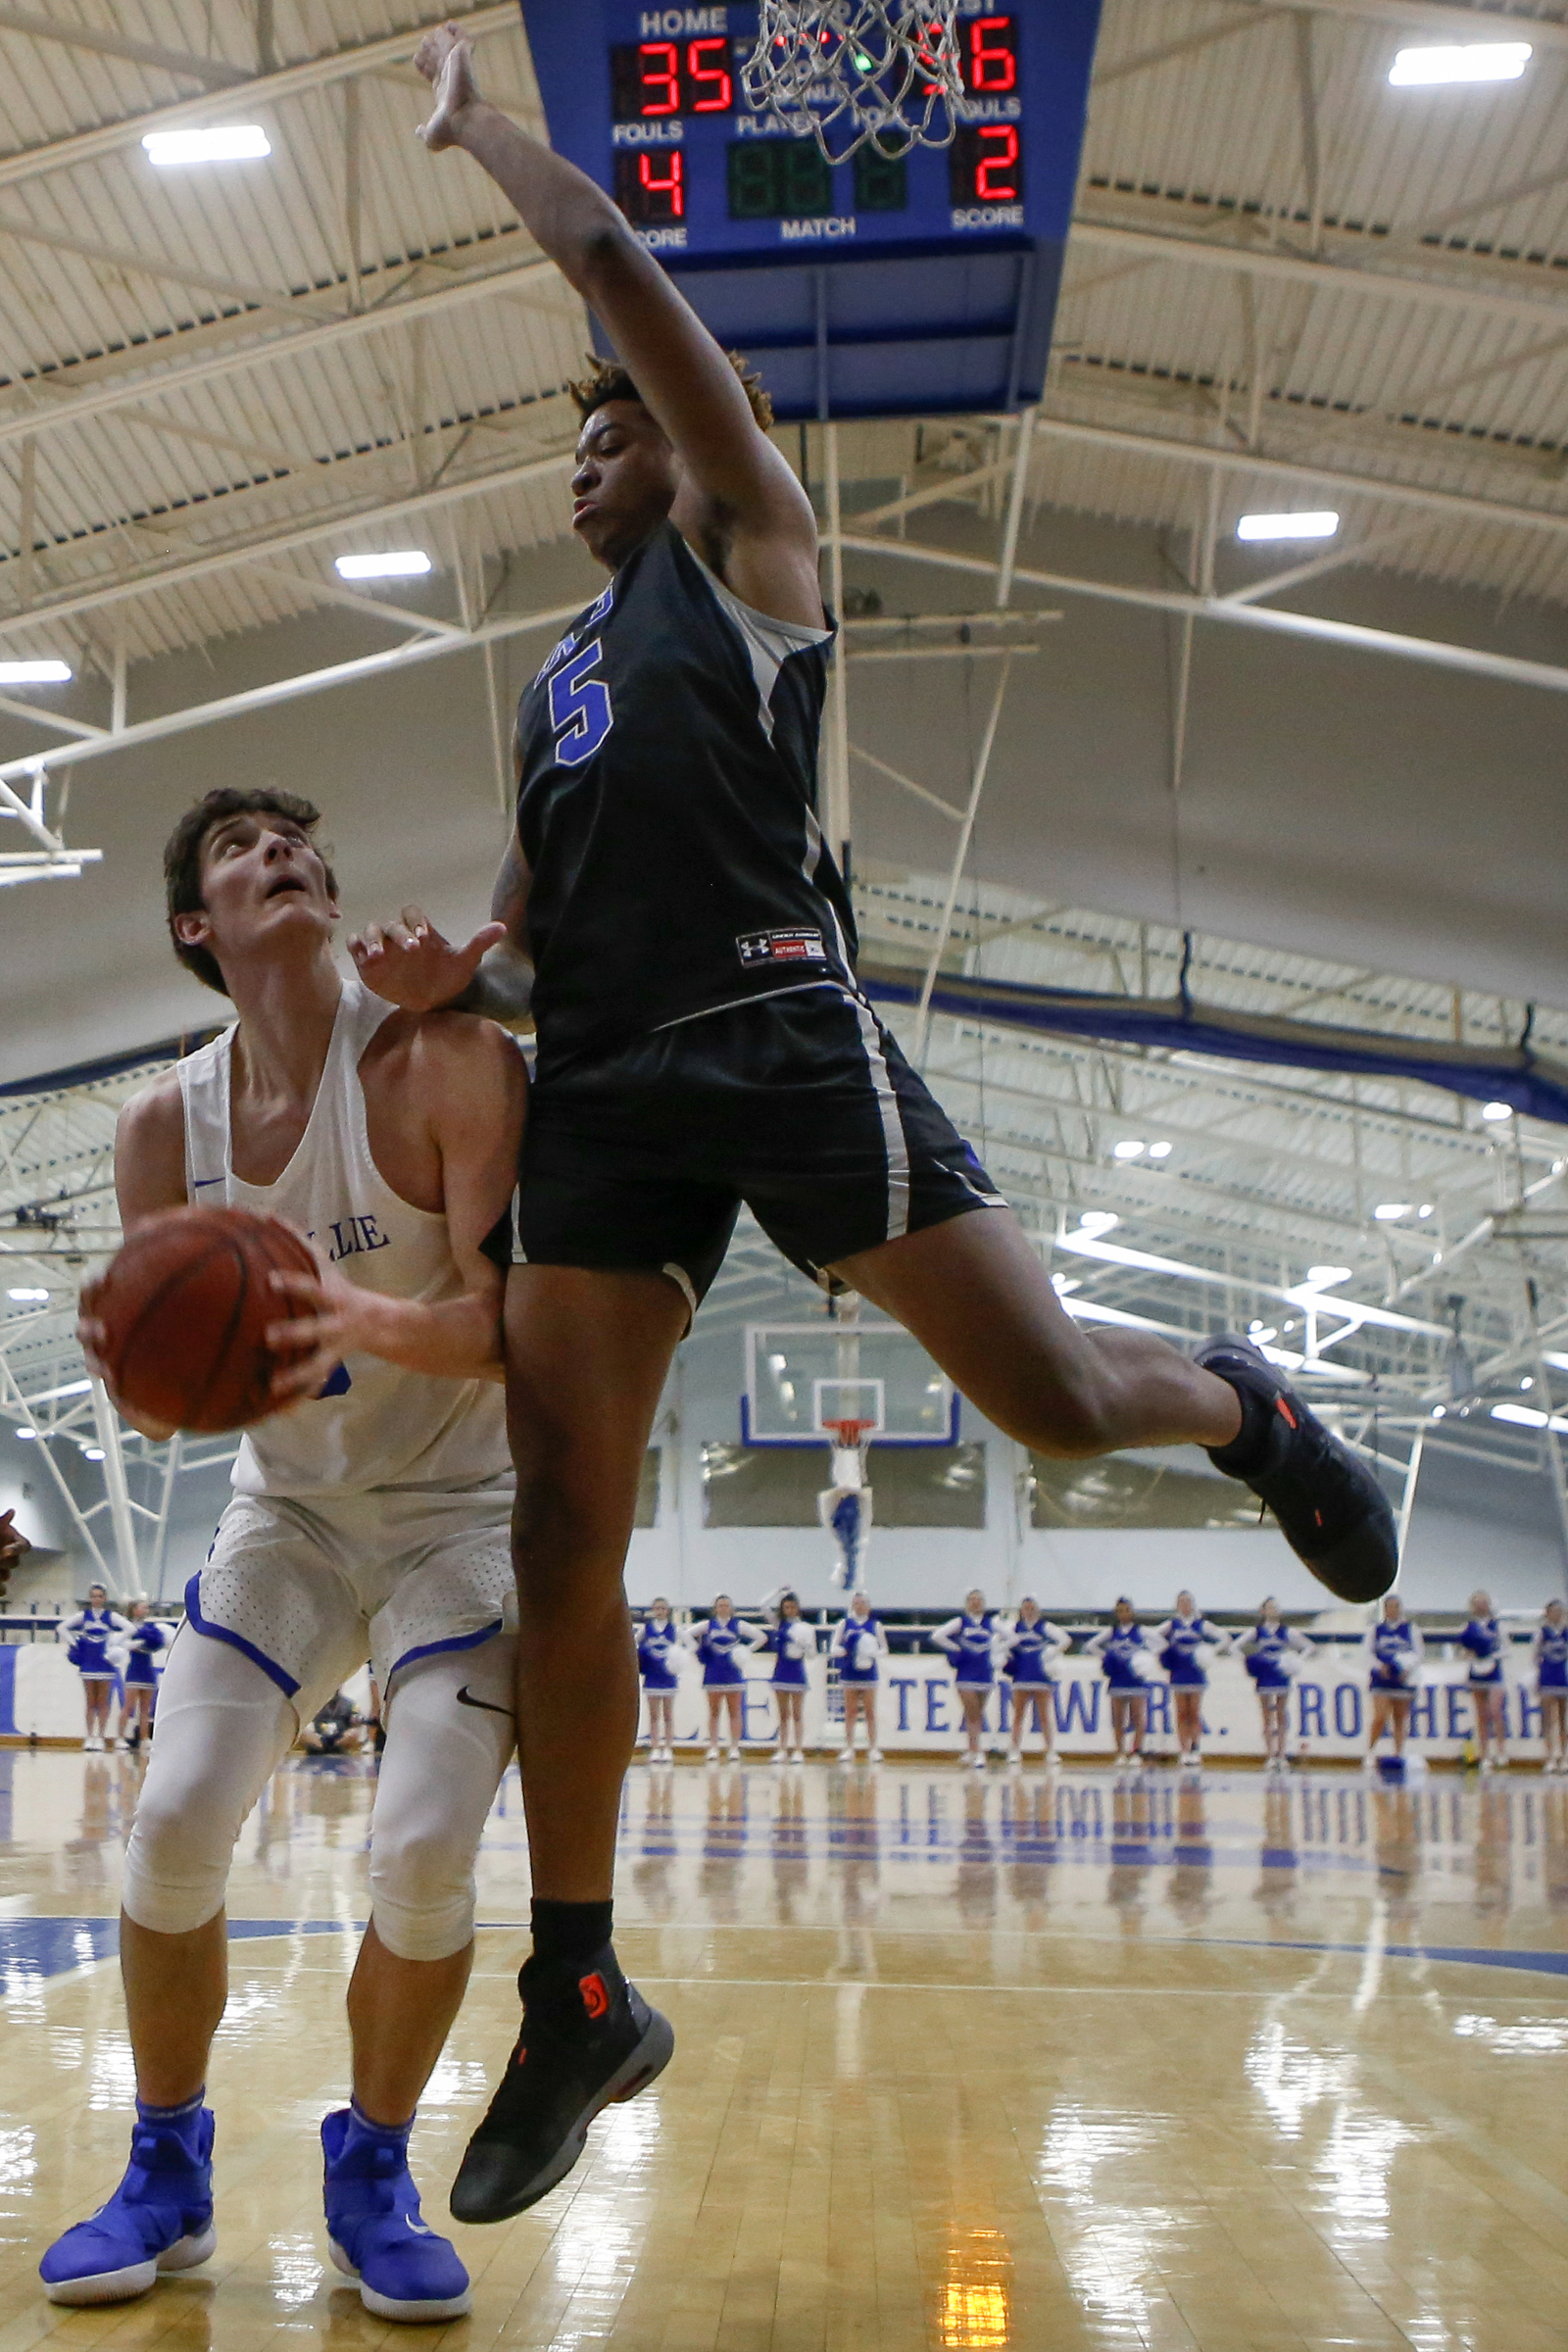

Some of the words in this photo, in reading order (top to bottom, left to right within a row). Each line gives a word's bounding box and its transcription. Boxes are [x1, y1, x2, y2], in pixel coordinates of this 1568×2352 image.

[640, 7, 727, 36] HOME
[639, 37, 732, 116] 35
[612, 121, 683, 144] FOULS
[640, 150, 683, 216] 4
[976, 124, 1018, 200] 2
[781, 217, 857, 240] MATCH
[952, 205, 1023, 229] SCORE
[548, 636, 614, 767] 5
